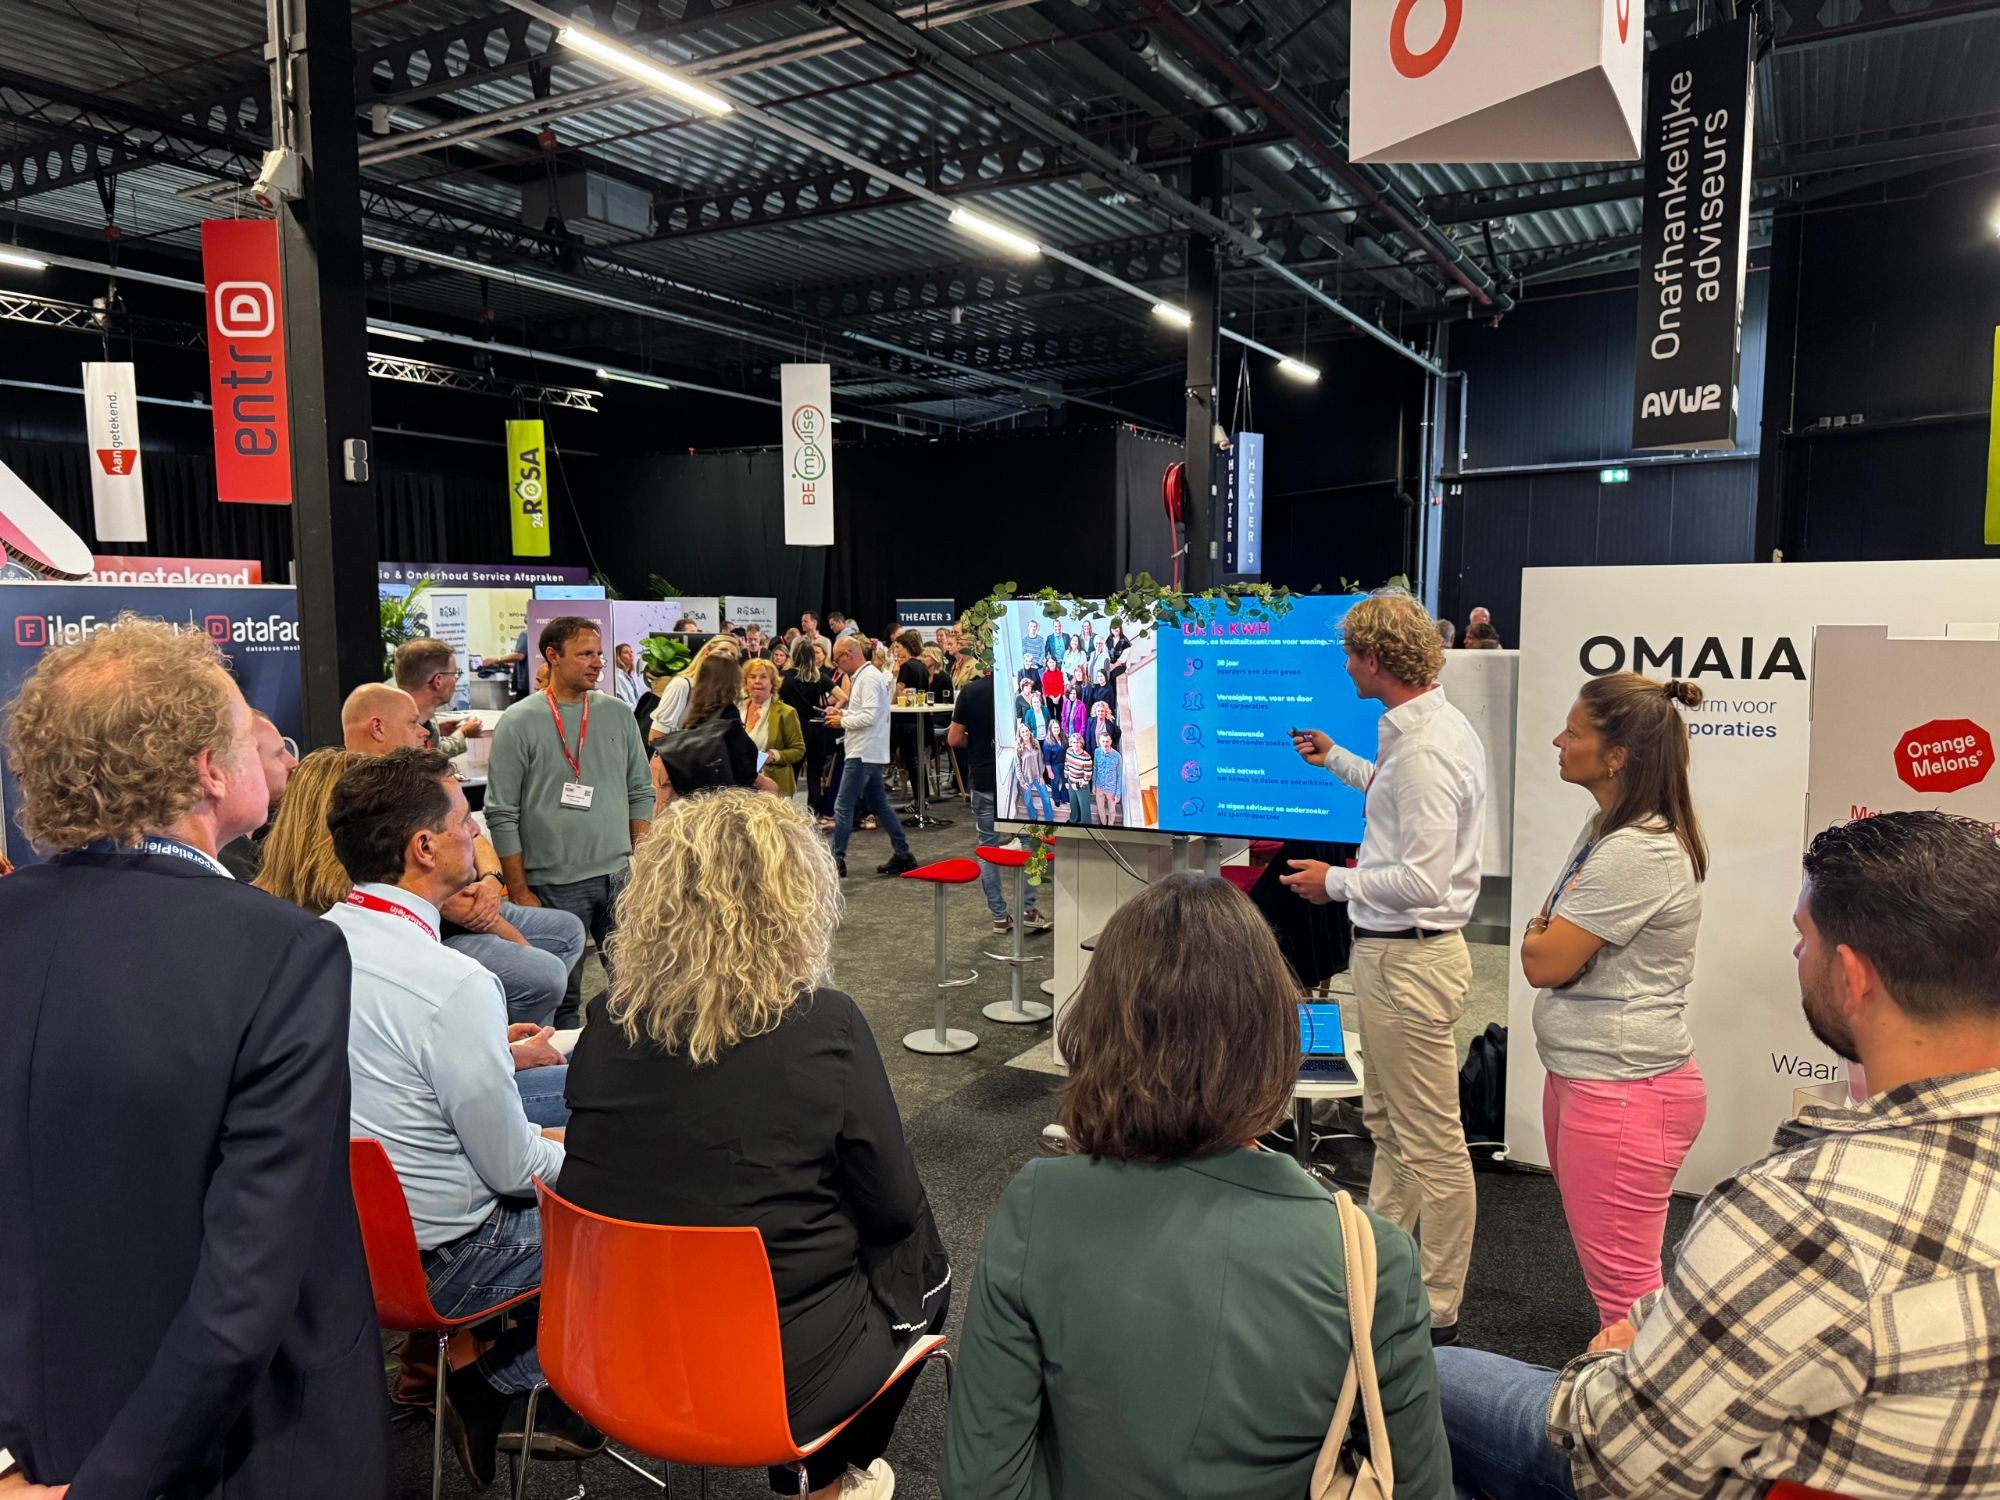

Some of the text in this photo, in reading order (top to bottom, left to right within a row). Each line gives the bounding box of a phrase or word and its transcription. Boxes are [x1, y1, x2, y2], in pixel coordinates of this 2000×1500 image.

[1651, 70, 1699, 361] Onafhankelijke
[1690, 108, 1729, 303] adviseurs
[1641, 383, 1722, 419] AVW2
[802, 482, 816, 506] BE
[1227, 444, 1235, 543] THEATER
[1248, 443, 1256, 564] THEATER 3
[394, 571, 402, 579] &
[406, 570, 469, 581] Onderhoud
[472, 572, 511, 582] Service
[514, 573, 564, 583] Afspraken
[900, 613, 952, 621] THEATER 3
[1211, 621, 1225, 636] is
[1229, 622, 1270, 636] KWH
[1219, 638, 1281, 646] kwaliteitscentrum
[1225, 659, 1239, 667] jaar
[1579, 635, 1807, 681] OMAIA
[1216, 694, 1253, 702] Vereniging
[1732, 699, 1777, 714] voor
[1907, 734, 1977, 758] Orange
[1285, 806, 1330, 815] onderzoeker
[1771, 1052, 1839, 1081] Waar
